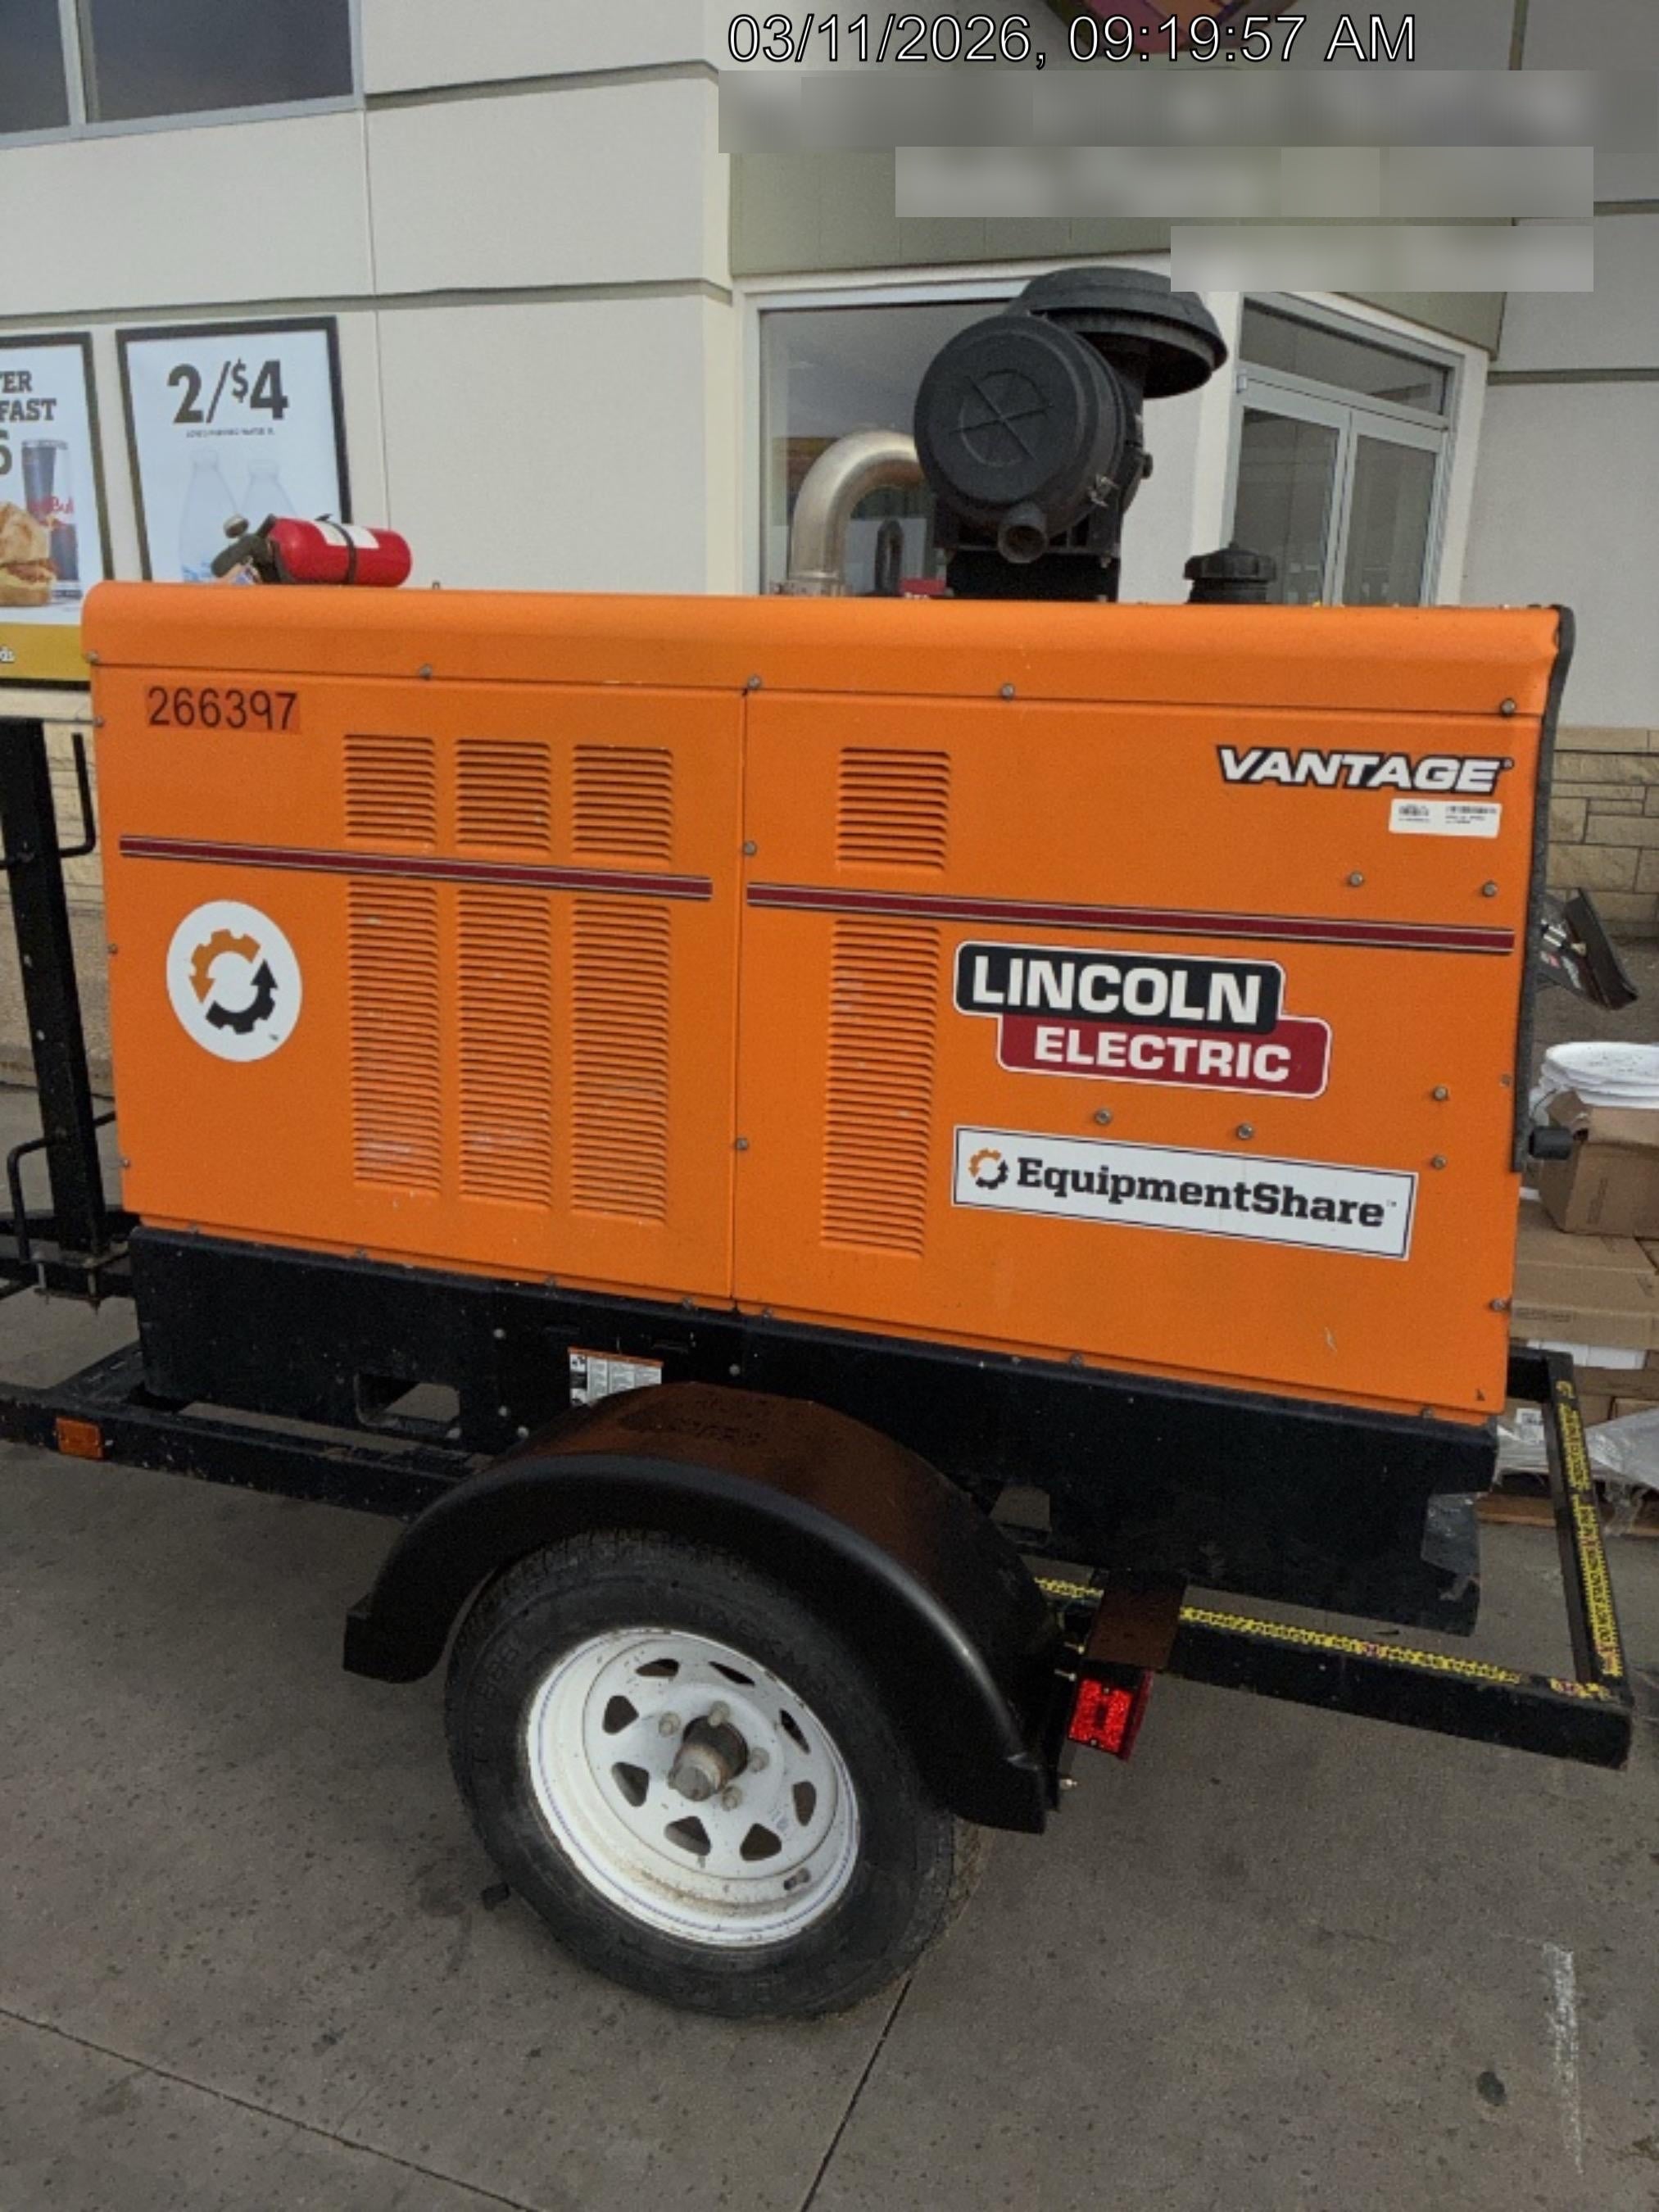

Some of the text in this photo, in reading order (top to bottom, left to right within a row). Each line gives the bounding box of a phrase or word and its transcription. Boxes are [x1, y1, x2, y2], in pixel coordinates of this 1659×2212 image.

[0, 370, 32, 393] ER
[167, 357, 290, 424] 2/$4
[148, 685, 298, 731] 266397
[1218, 746, 1503, 796] VANTAGE
[972, 954, 1262, 1025] LINCOLN
[1034, 1025, 1292, 1082] ELECTRIC
[1016, 1156, 1385, 1228] EquipmentShare
